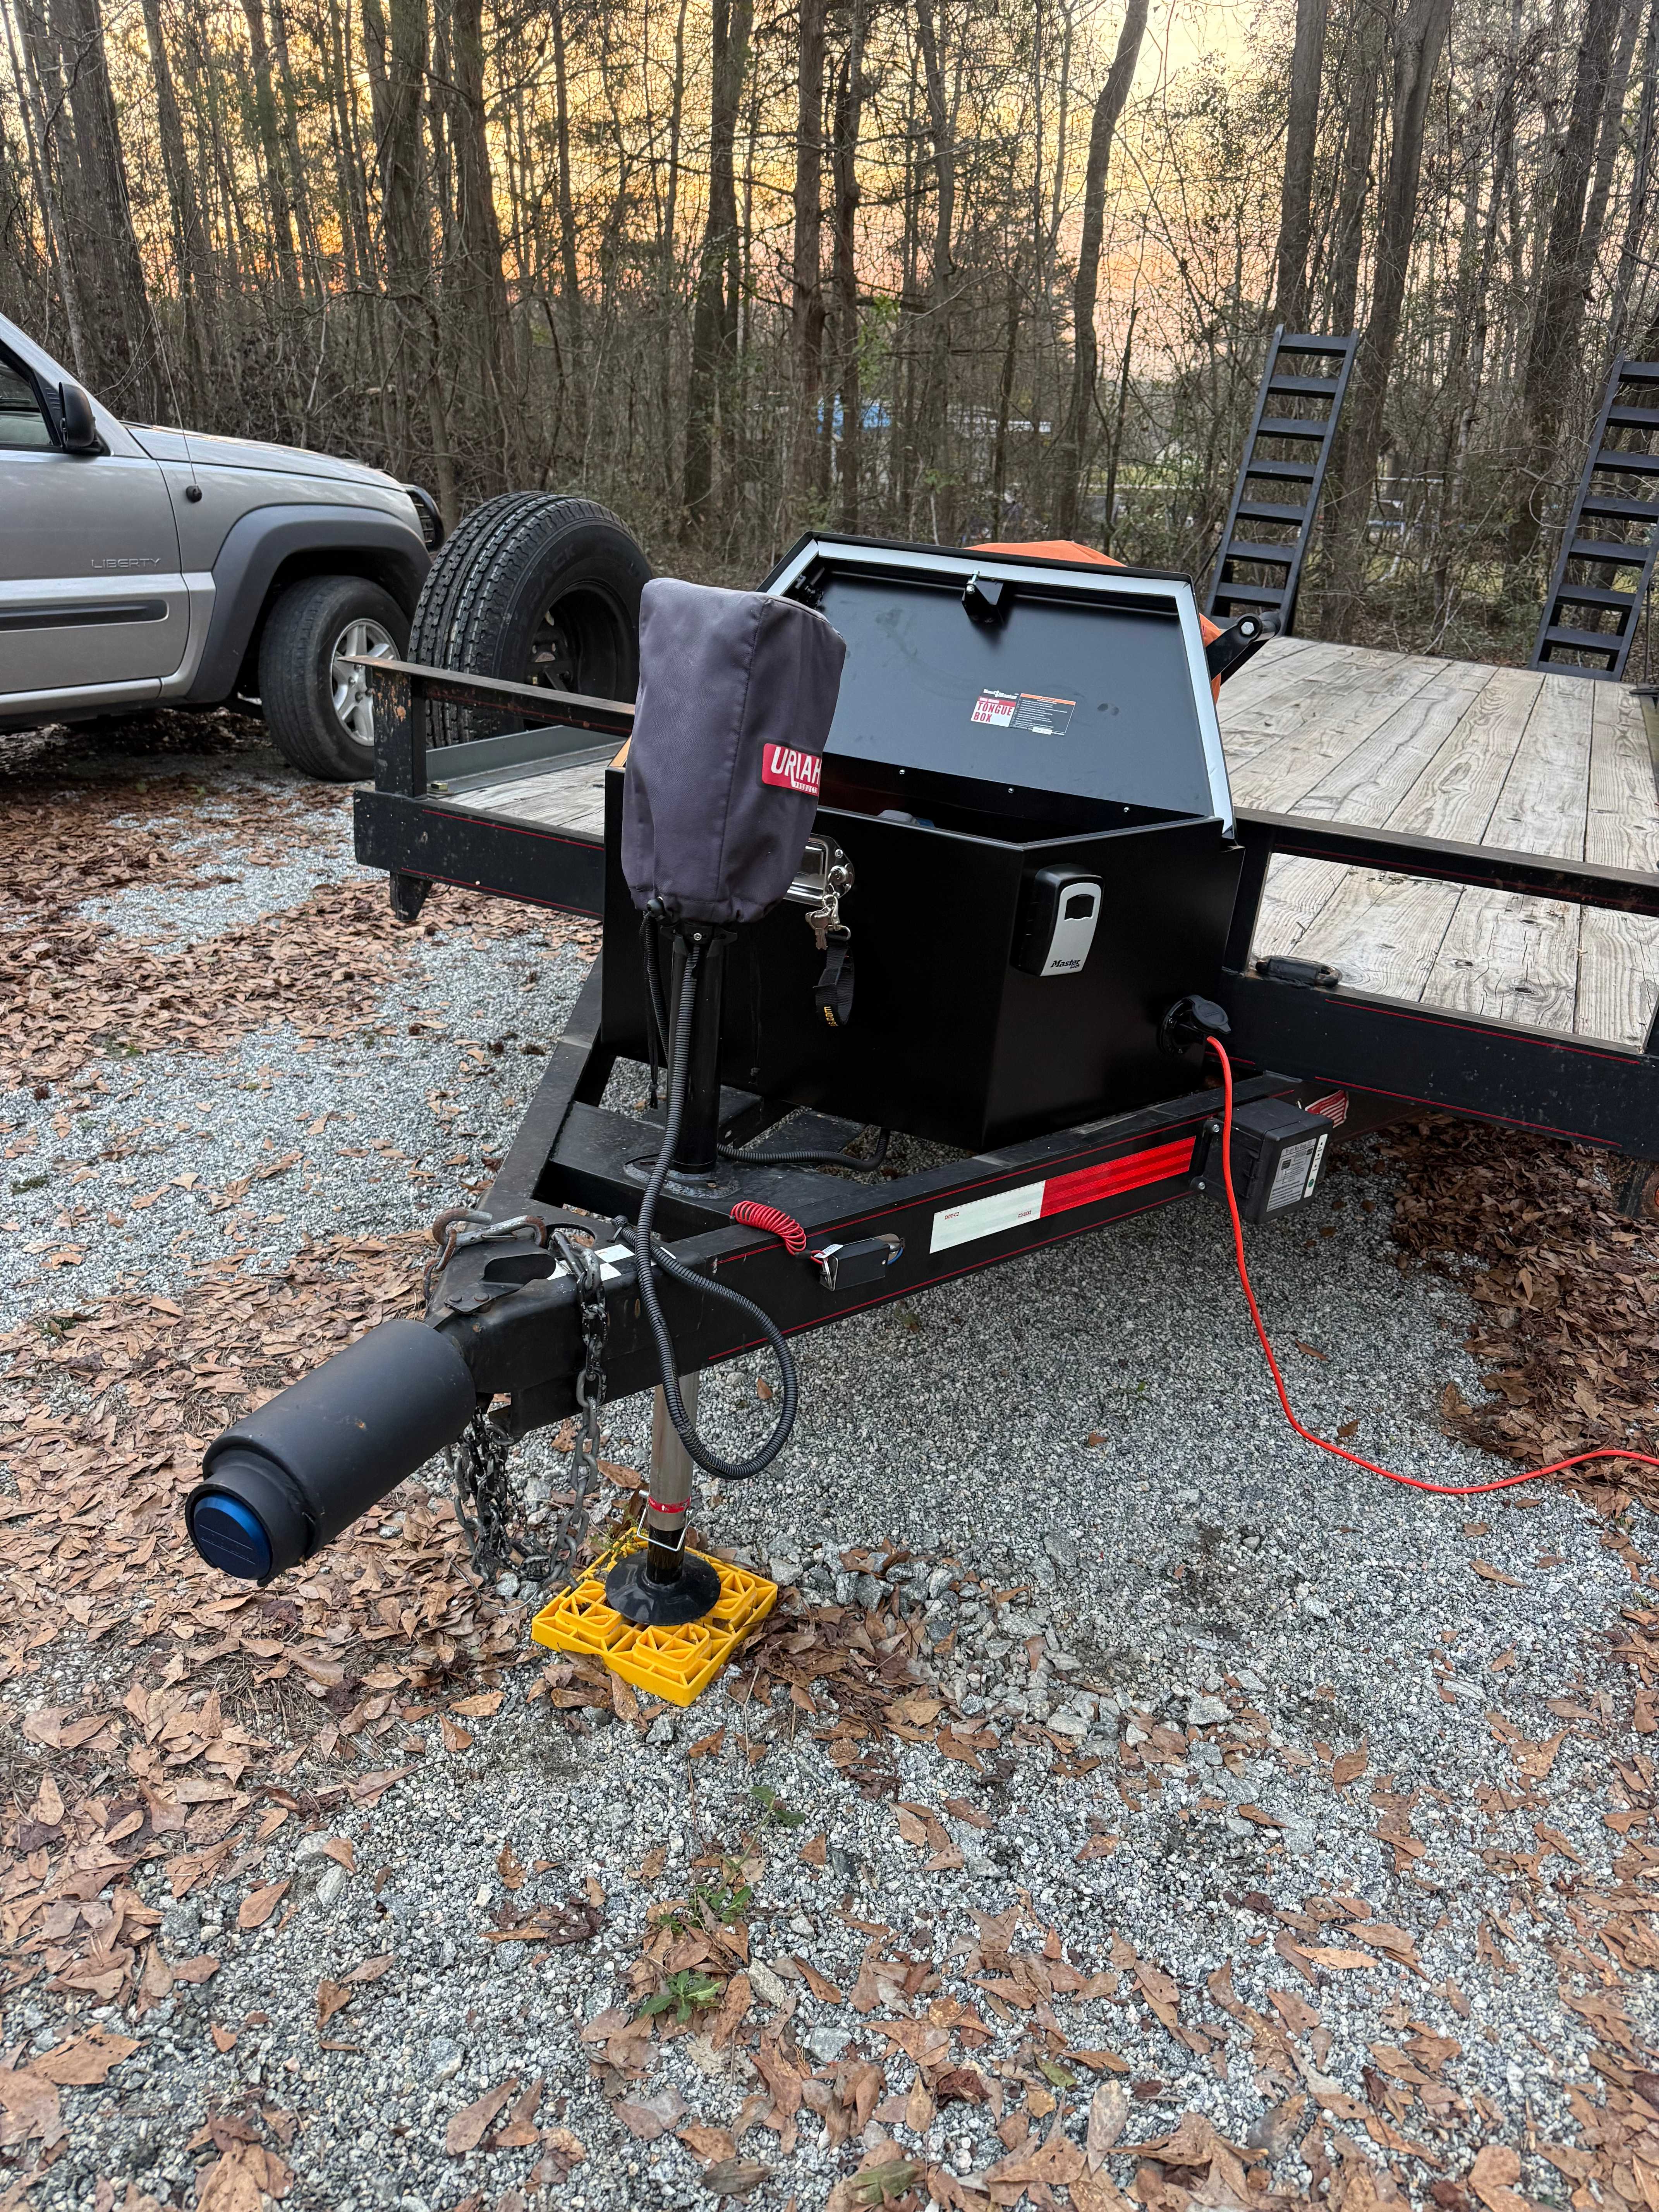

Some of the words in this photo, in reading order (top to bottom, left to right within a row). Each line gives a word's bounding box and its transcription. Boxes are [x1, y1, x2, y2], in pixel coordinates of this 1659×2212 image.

[91, 558, 161, 568] LIBERTY
[977, 702, 1013, 716] TONGUE
[974, 712, 992, 722] BOX
[771, 747, 822, 787] URIAH
